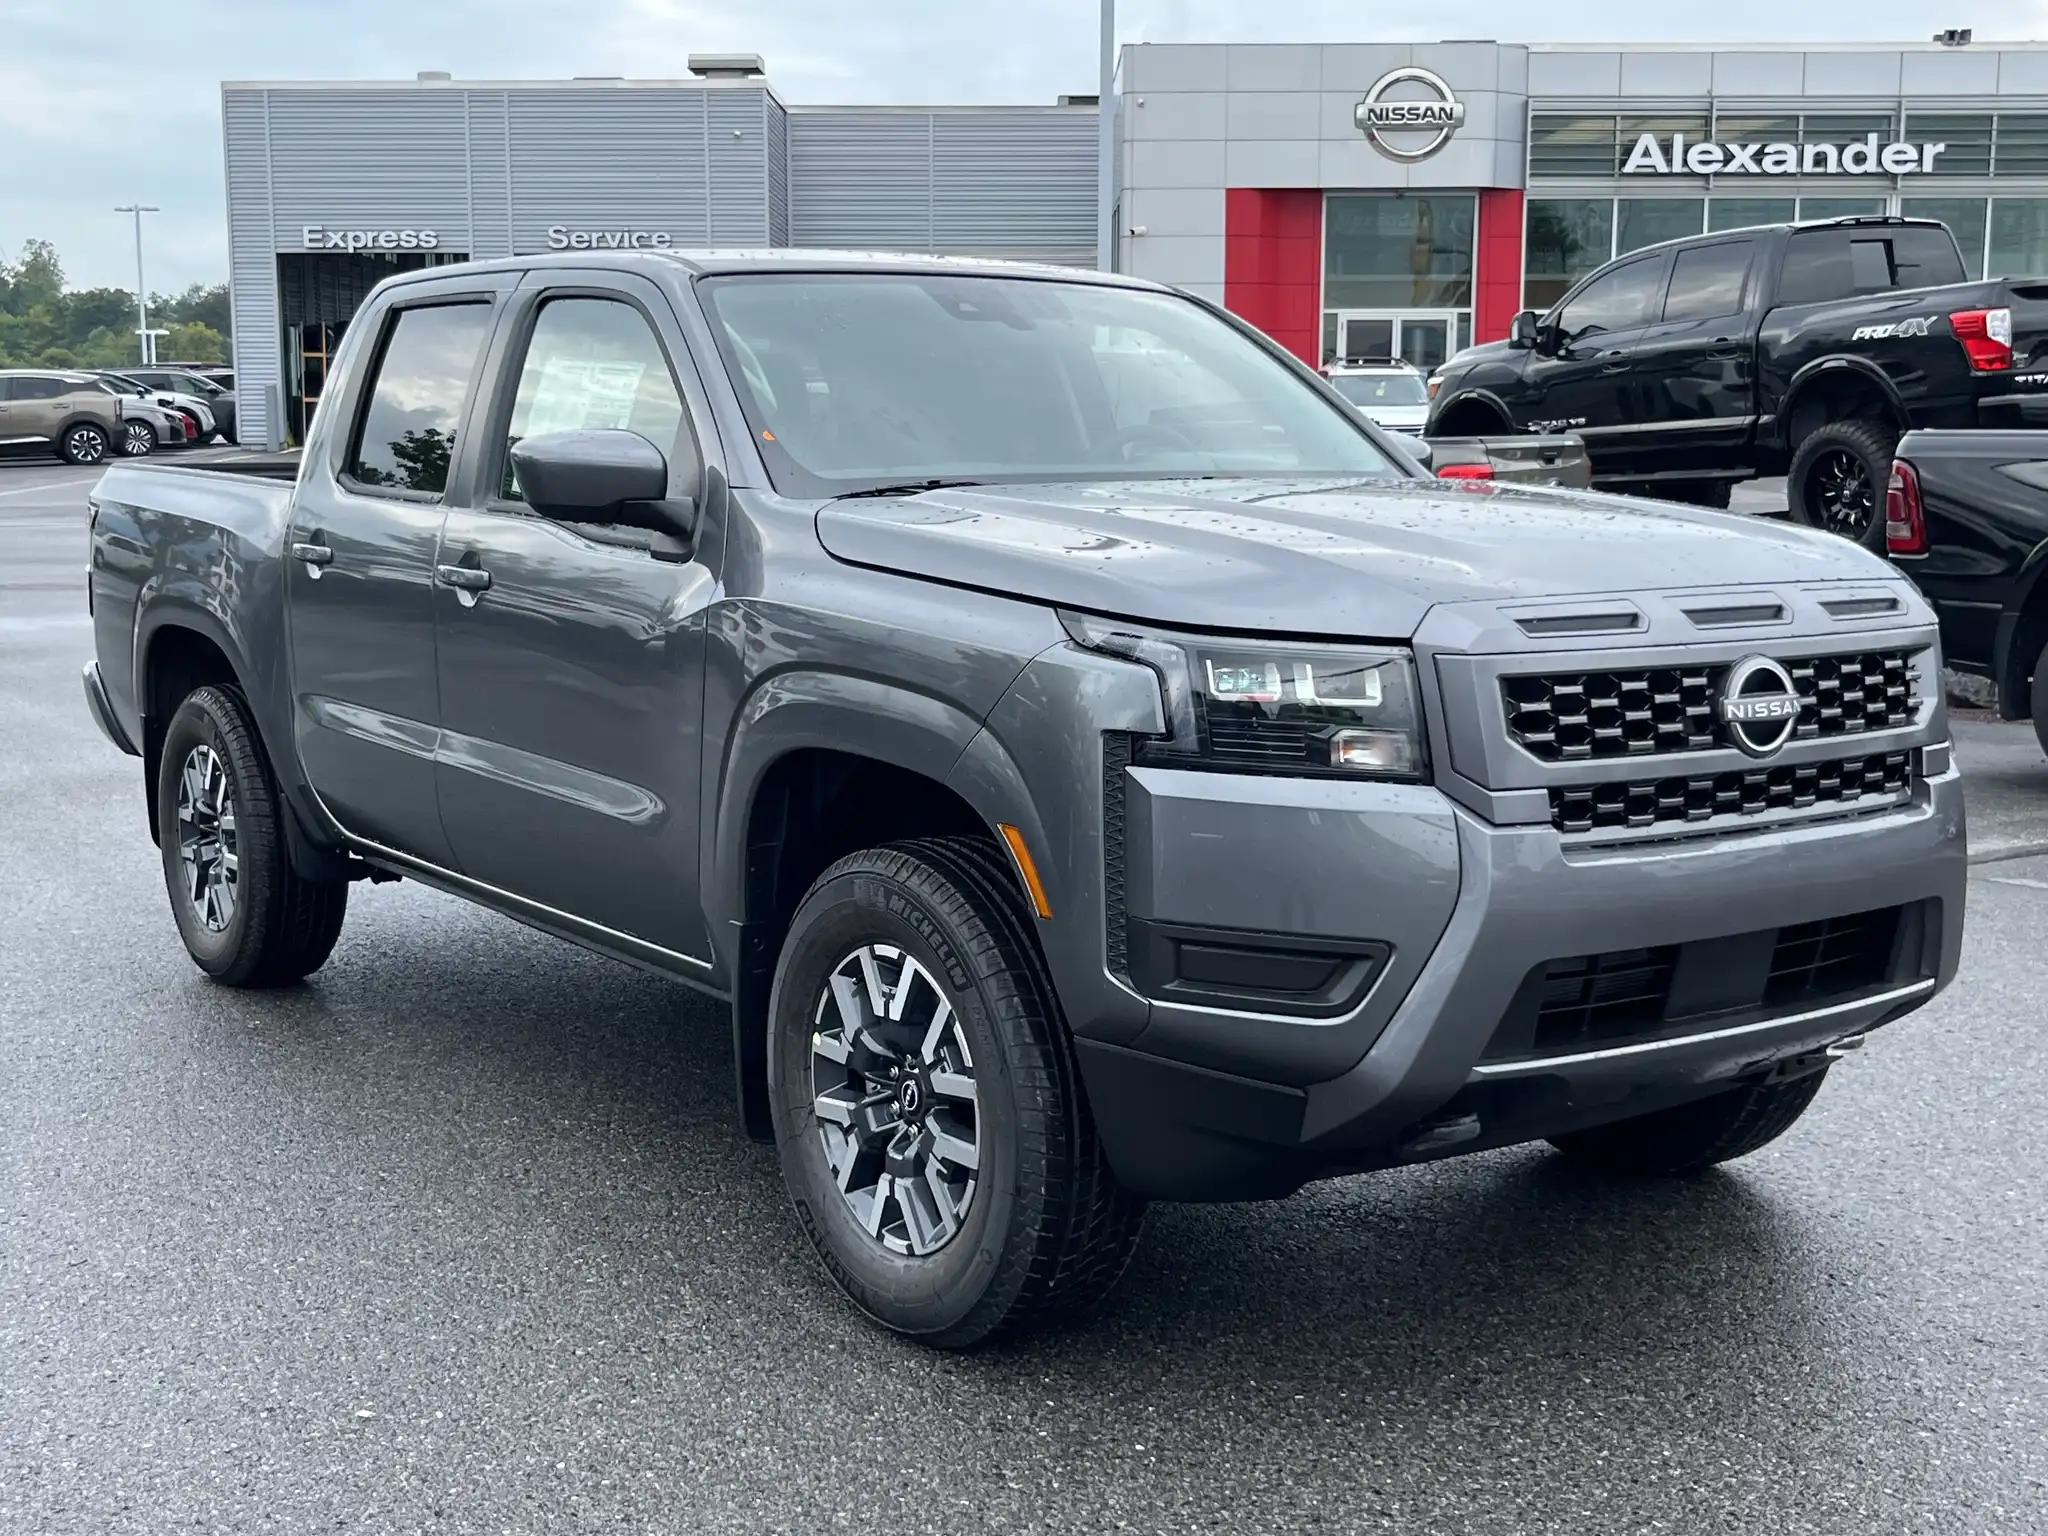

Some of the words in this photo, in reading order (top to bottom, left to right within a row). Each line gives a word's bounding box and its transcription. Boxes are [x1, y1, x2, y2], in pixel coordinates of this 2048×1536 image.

[1367, 106, 1454, 123] NISSAN
[1622, 132, 1946, 174] Alexander
[302, 225, 439, 253] Express
[548, 225, 672, 250] Service
[1727, 699, 1802, 719] NISSAN
[888, 894, 968, 986] MICHELIN
